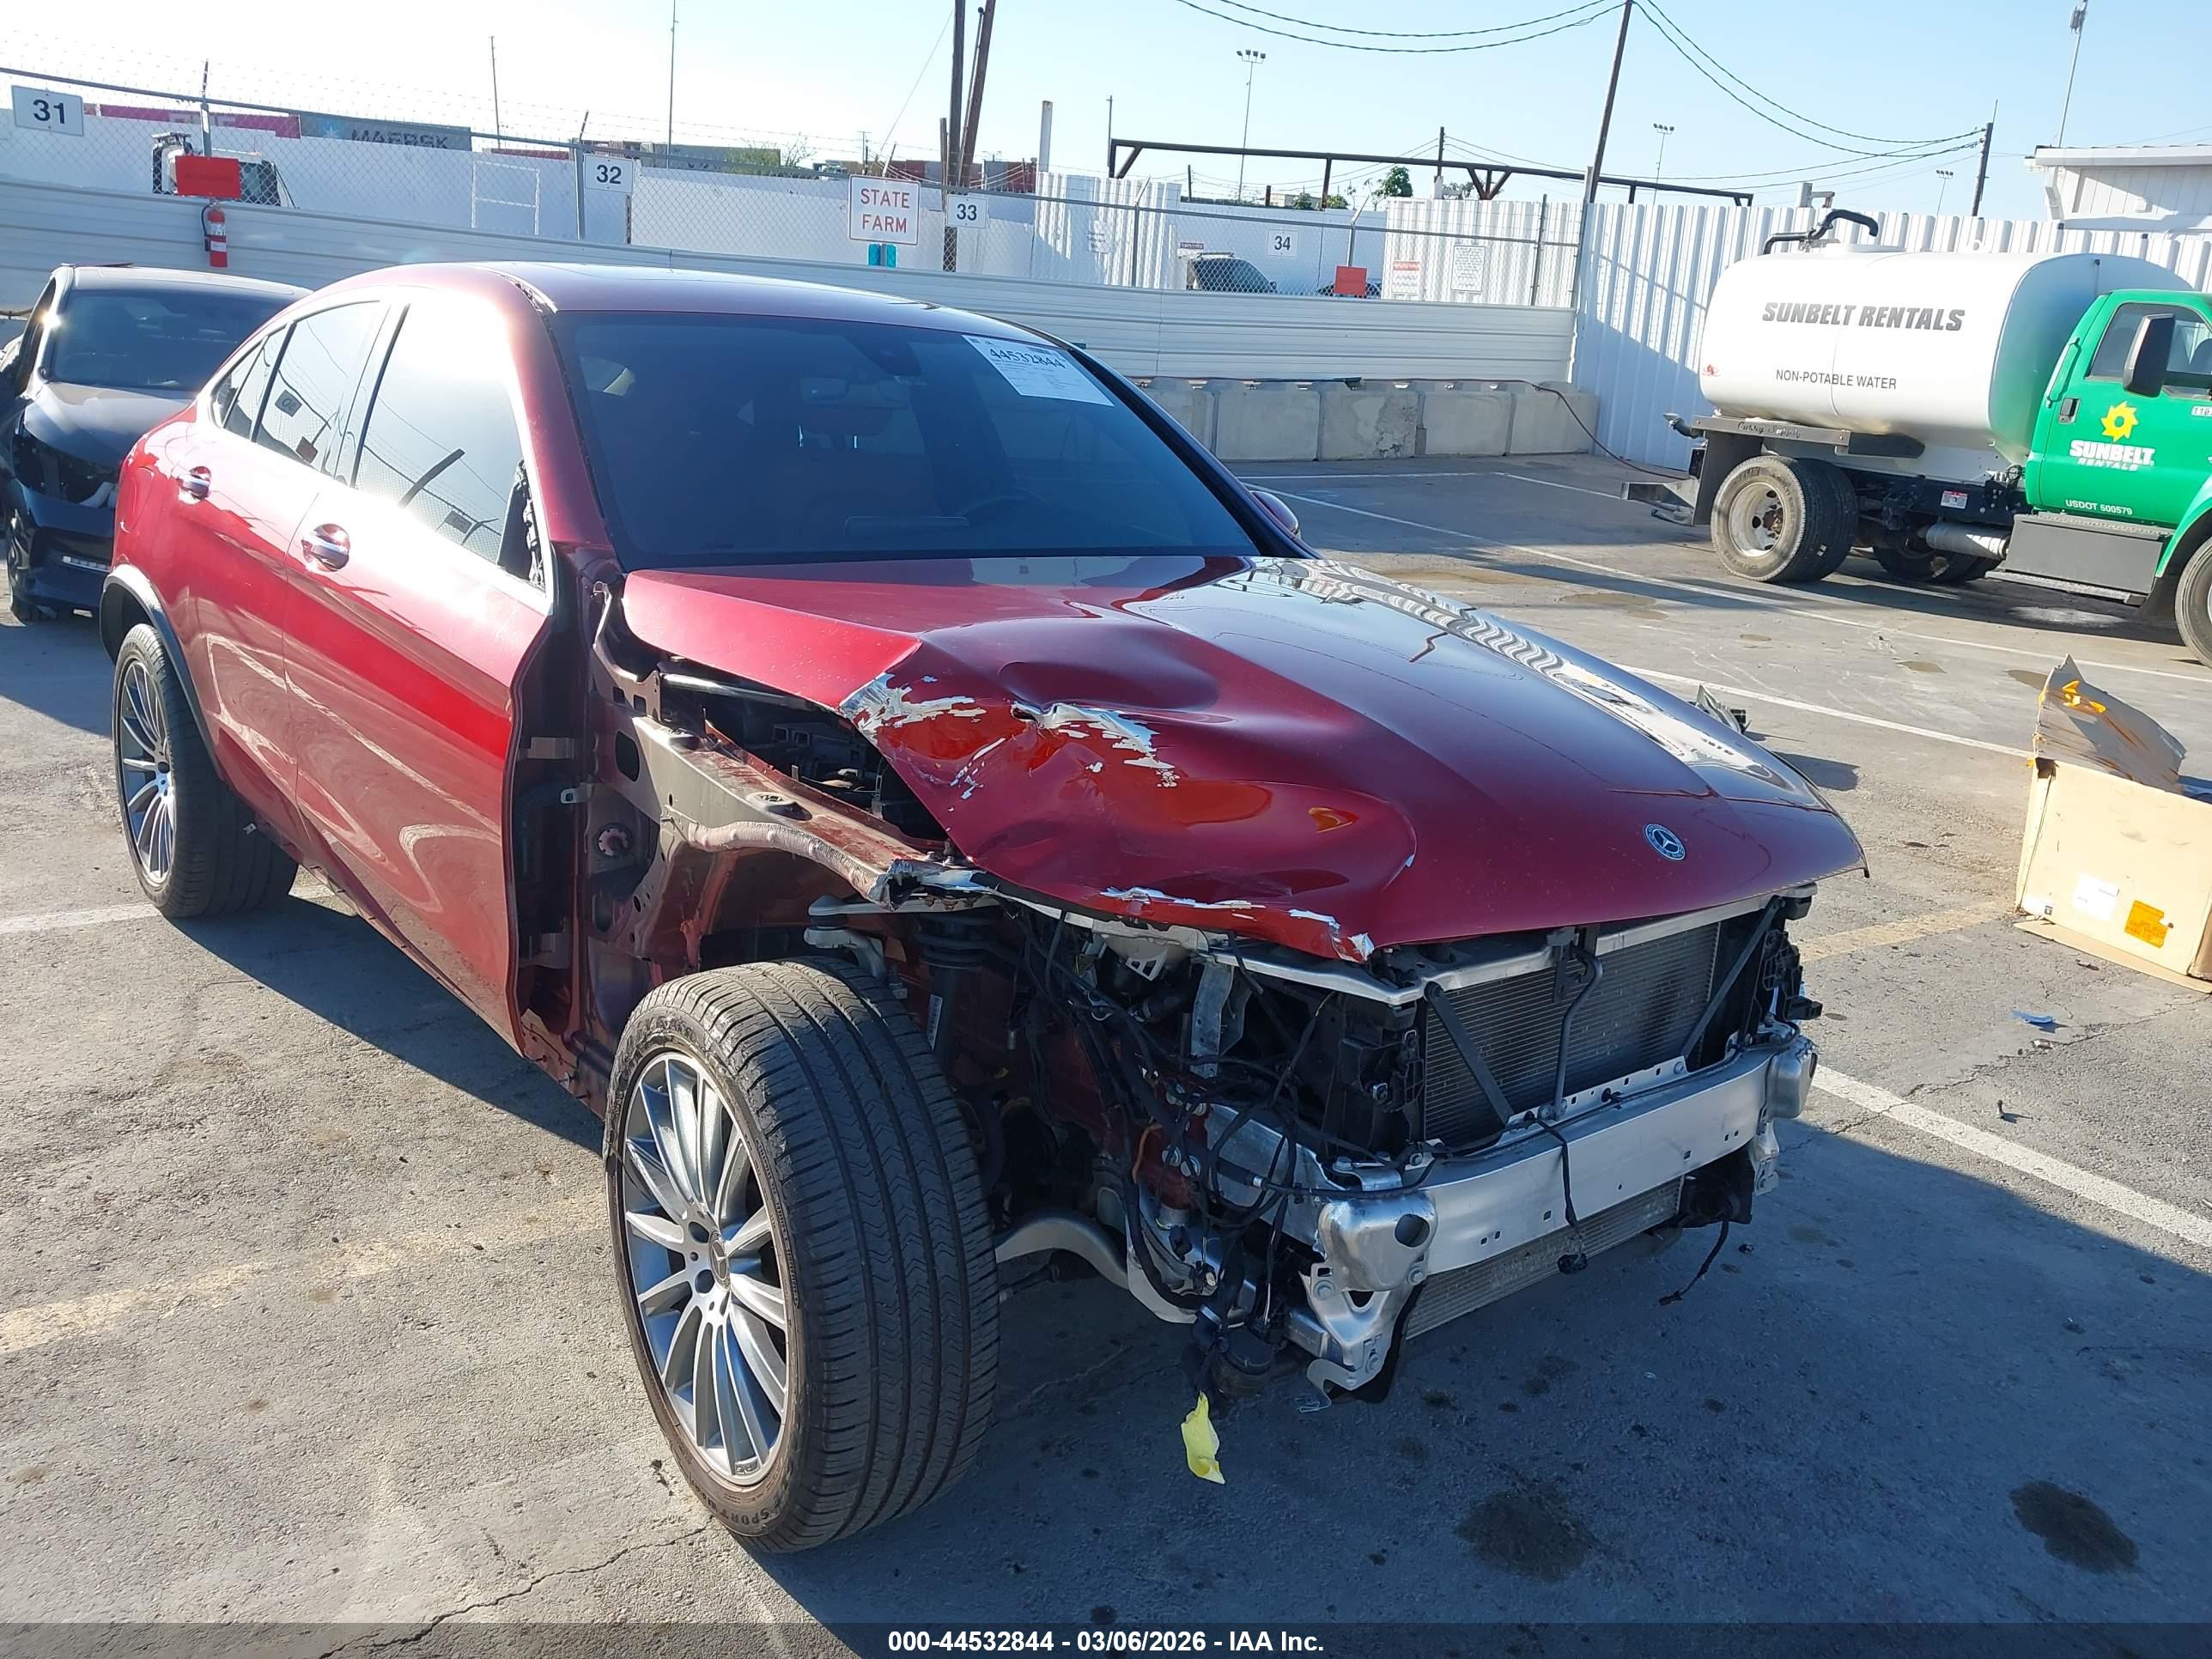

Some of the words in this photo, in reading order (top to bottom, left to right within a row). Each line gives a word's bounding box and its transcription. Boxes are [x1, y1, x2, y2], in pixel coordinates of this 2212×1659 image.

[32, 98, 67, 125] 31
[596, 164, 623, 185] 32
[860, 187, 910, 210] STATE
[956, 203, 977, 222] 33
[861, 213, 908, 234] FARM
[1273, 235, 1291, 251] 34
[1762, 301, 1856, 326] SUNBELT
[1858, 306, 1965, 331] RENTALS
[989, 348, 1066, 369] 44532844
[1776, 368, 1854, 388] NON-POTABLE
[1857, 374, 1897, 391] WATER
[2076, 458, 2139, 471] RENTALS
[2065, 499, 2097, 511] USDOT
[2100, 503, 2133, 516] 500579
